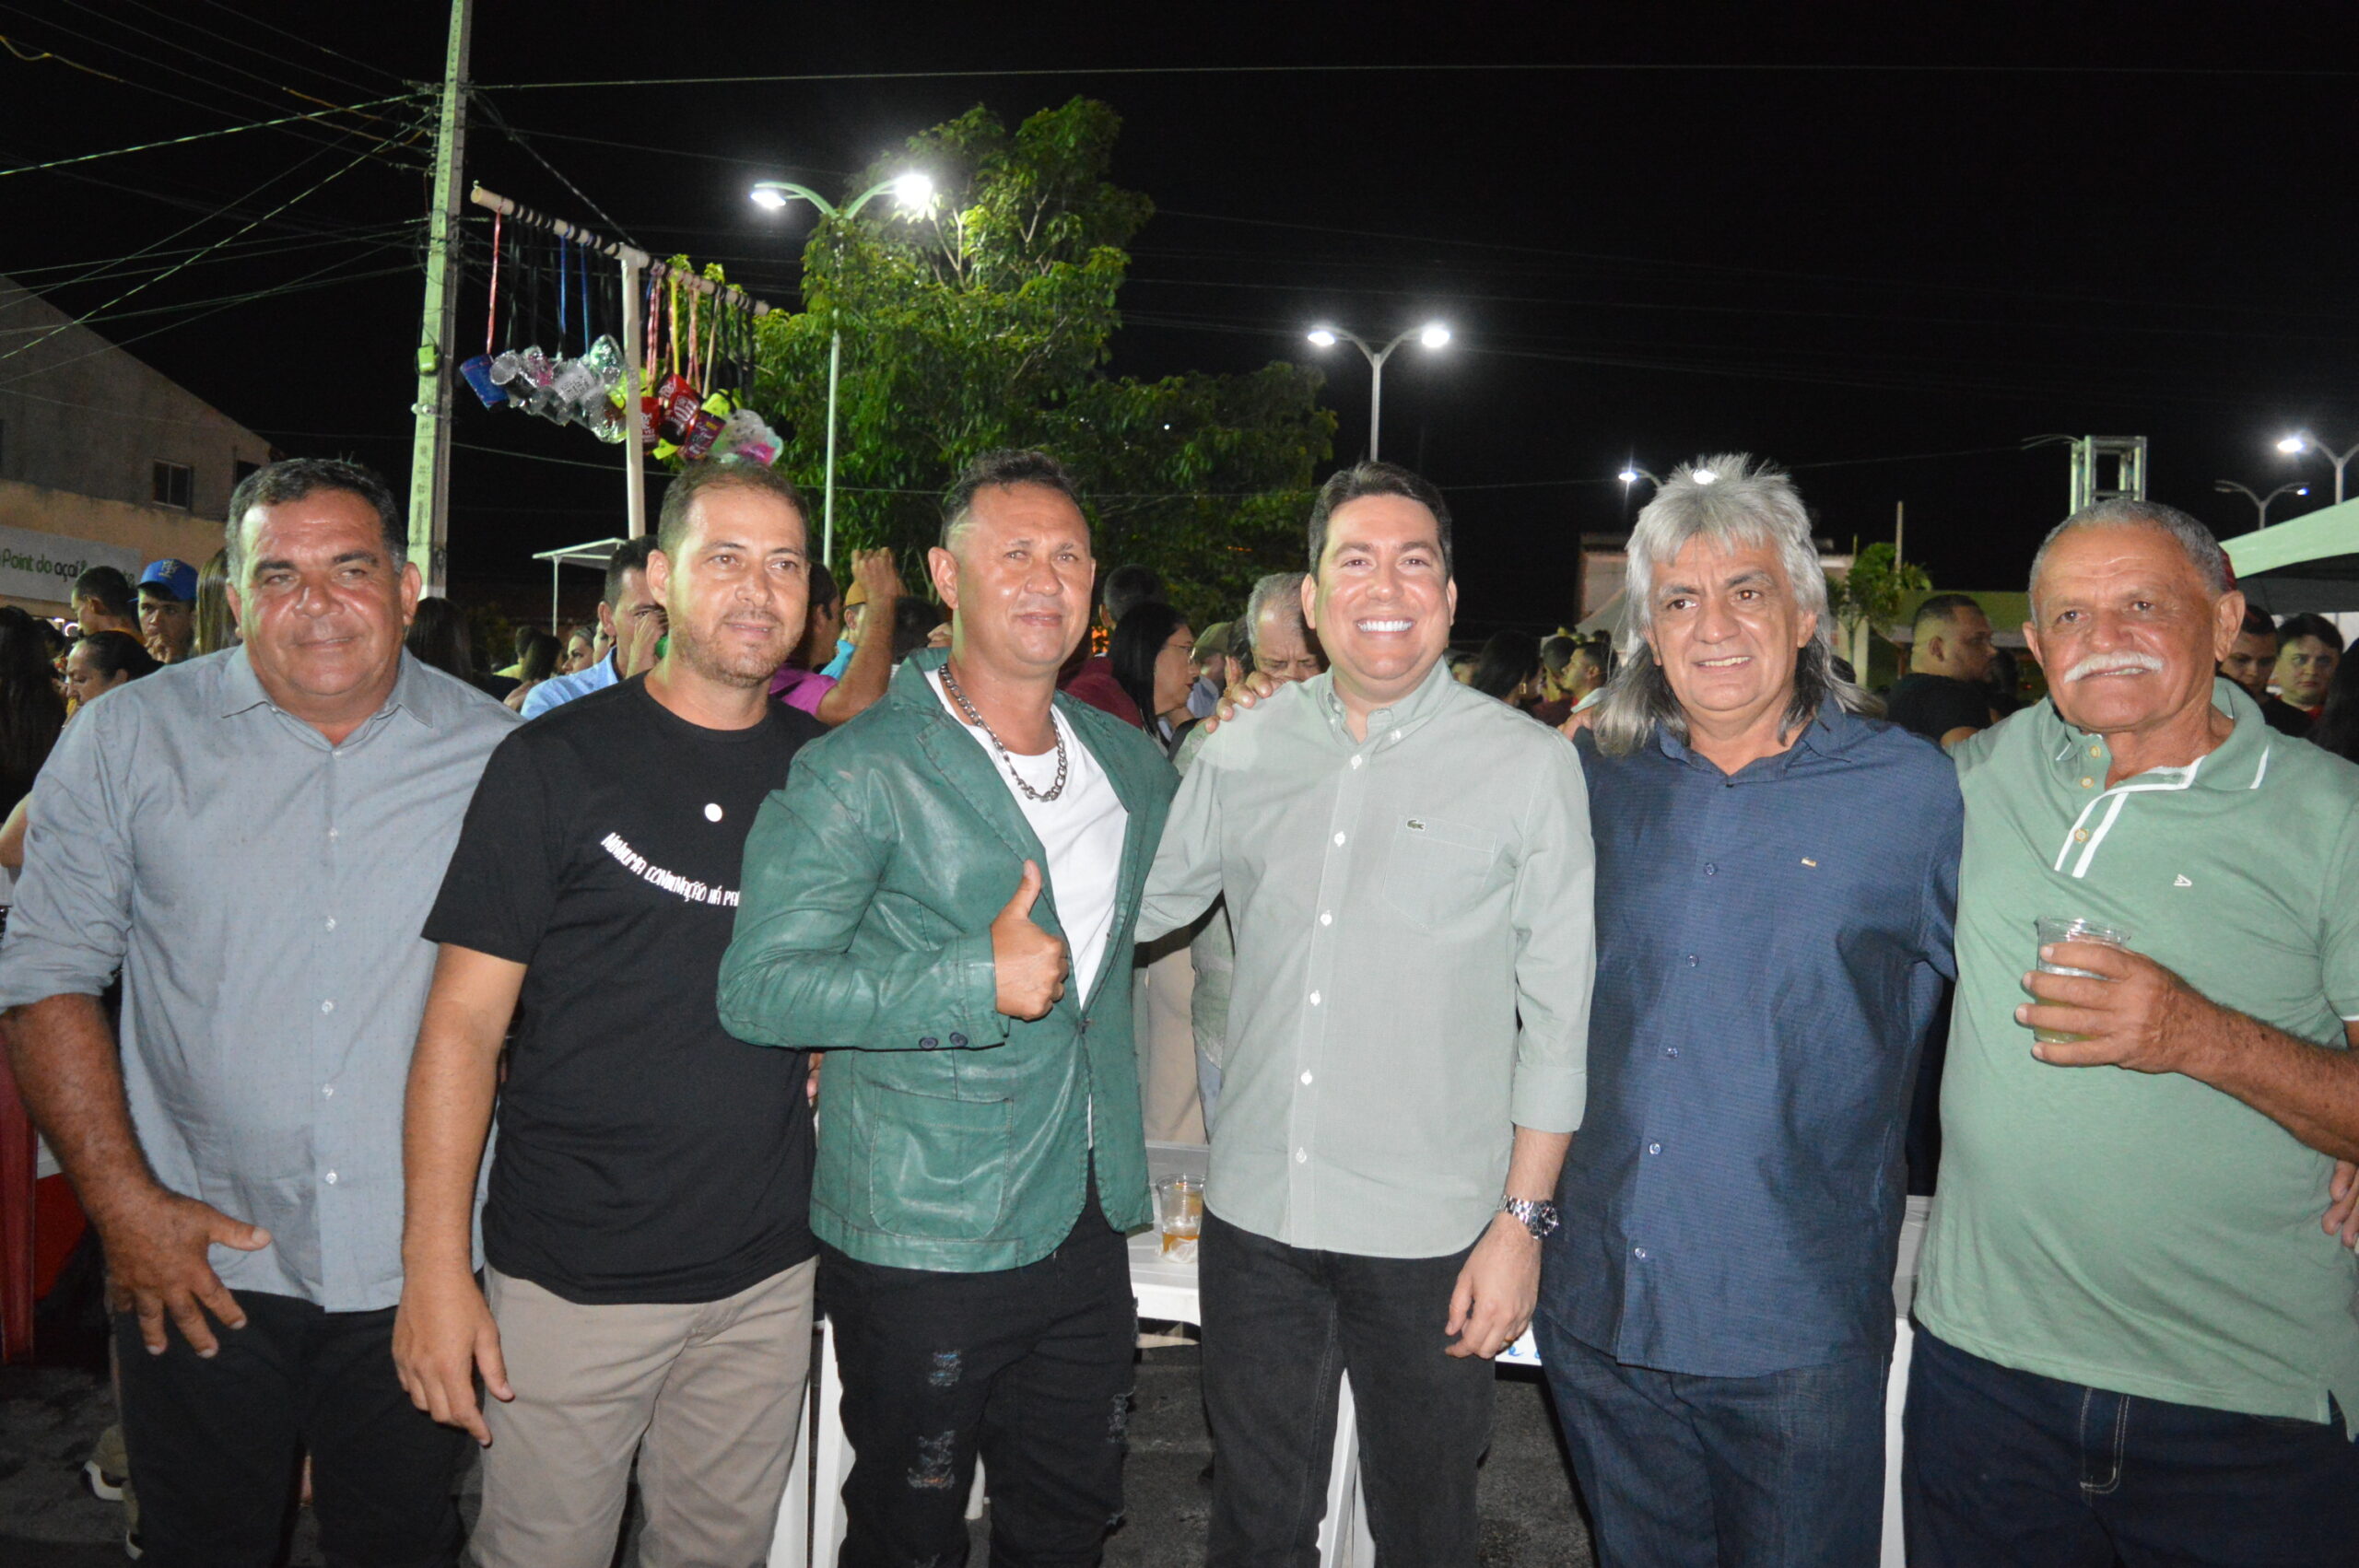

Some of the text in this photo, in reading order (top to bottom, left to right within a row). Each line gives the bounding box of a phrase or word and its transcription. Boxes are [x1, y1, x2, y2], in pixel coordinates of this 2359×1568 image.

[2, 548, 34, 572] Point
[36, 554, 53, 574] do
[54, 560, 80, 582] açaí
[644, 866, 707, 903] CONDENAÇÃO
[707, 884, 722, 906] HÁ
